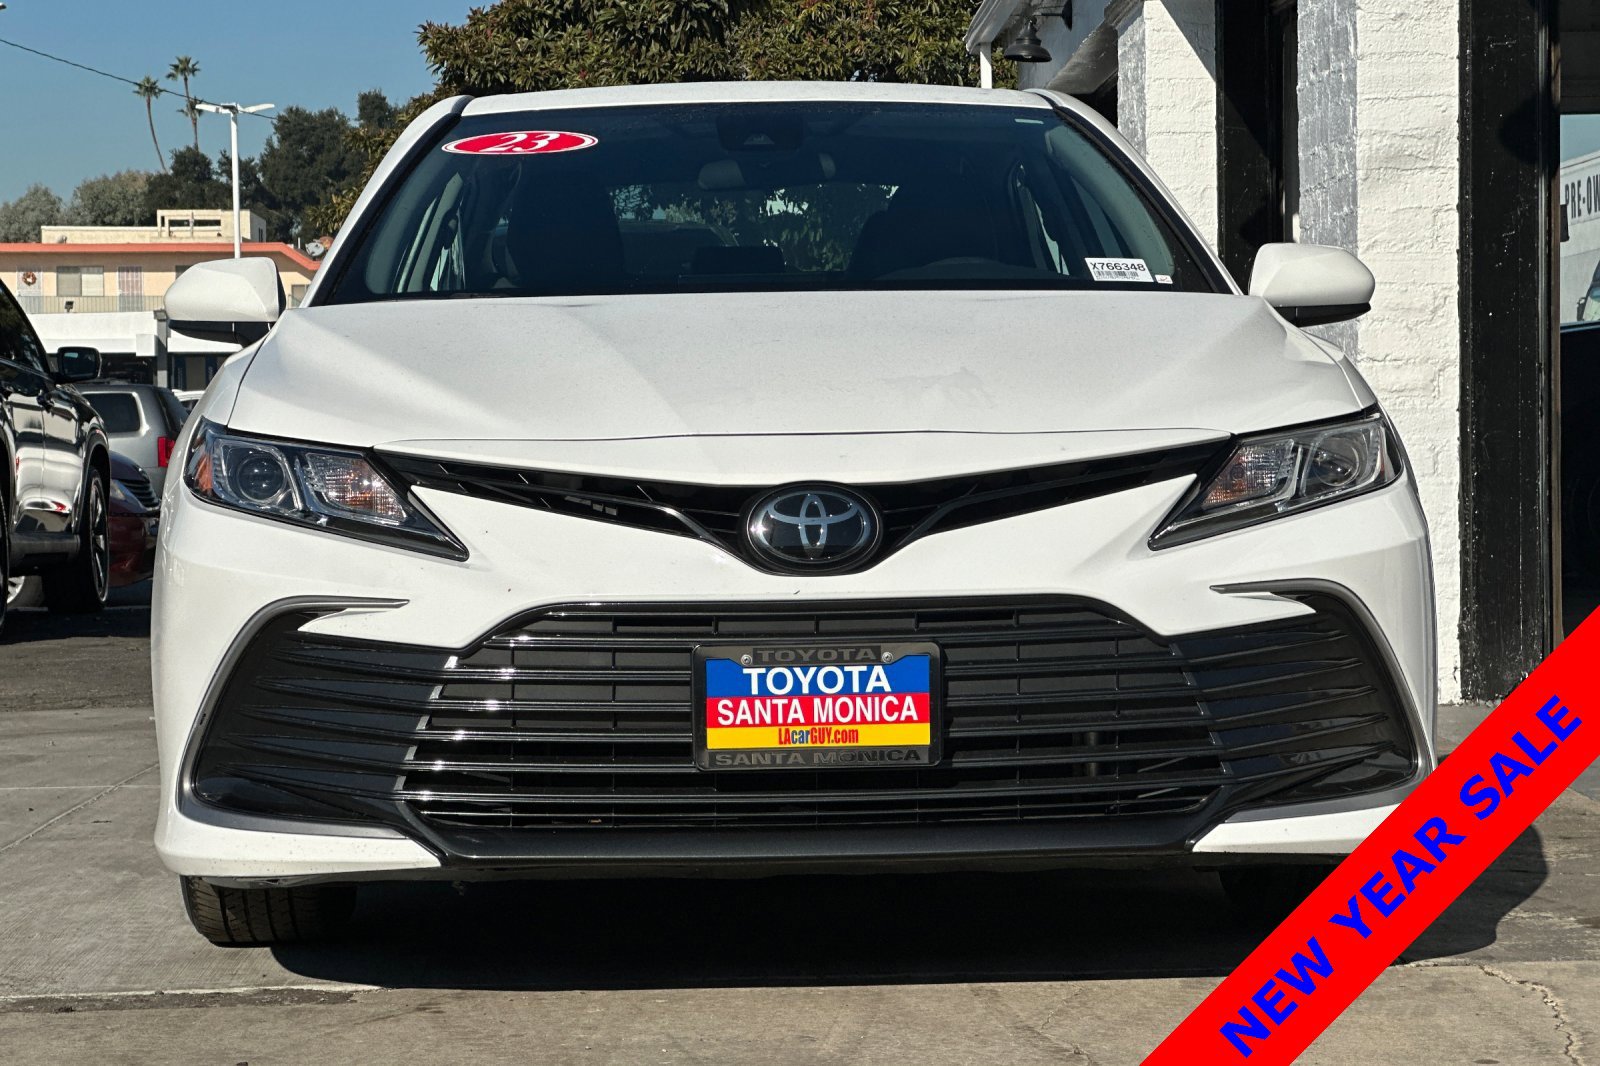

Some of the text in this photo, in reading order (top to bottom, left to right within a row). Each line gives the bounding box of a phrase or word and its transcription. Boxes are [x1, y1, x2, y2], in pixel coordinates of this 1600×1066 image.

[478, 133, 560, 152] 23
[1090, 262, 1146, 272] X766348
[757, 648, 876, 662] TOYOTA
[743, 665, 891, 695] TOYOTA
[717, 696, 918, 725] SANTA MONICA
[778, 727, 859, 745] LAcarGUY.com
[715, 749, 921, 766] SANTA MONICA
